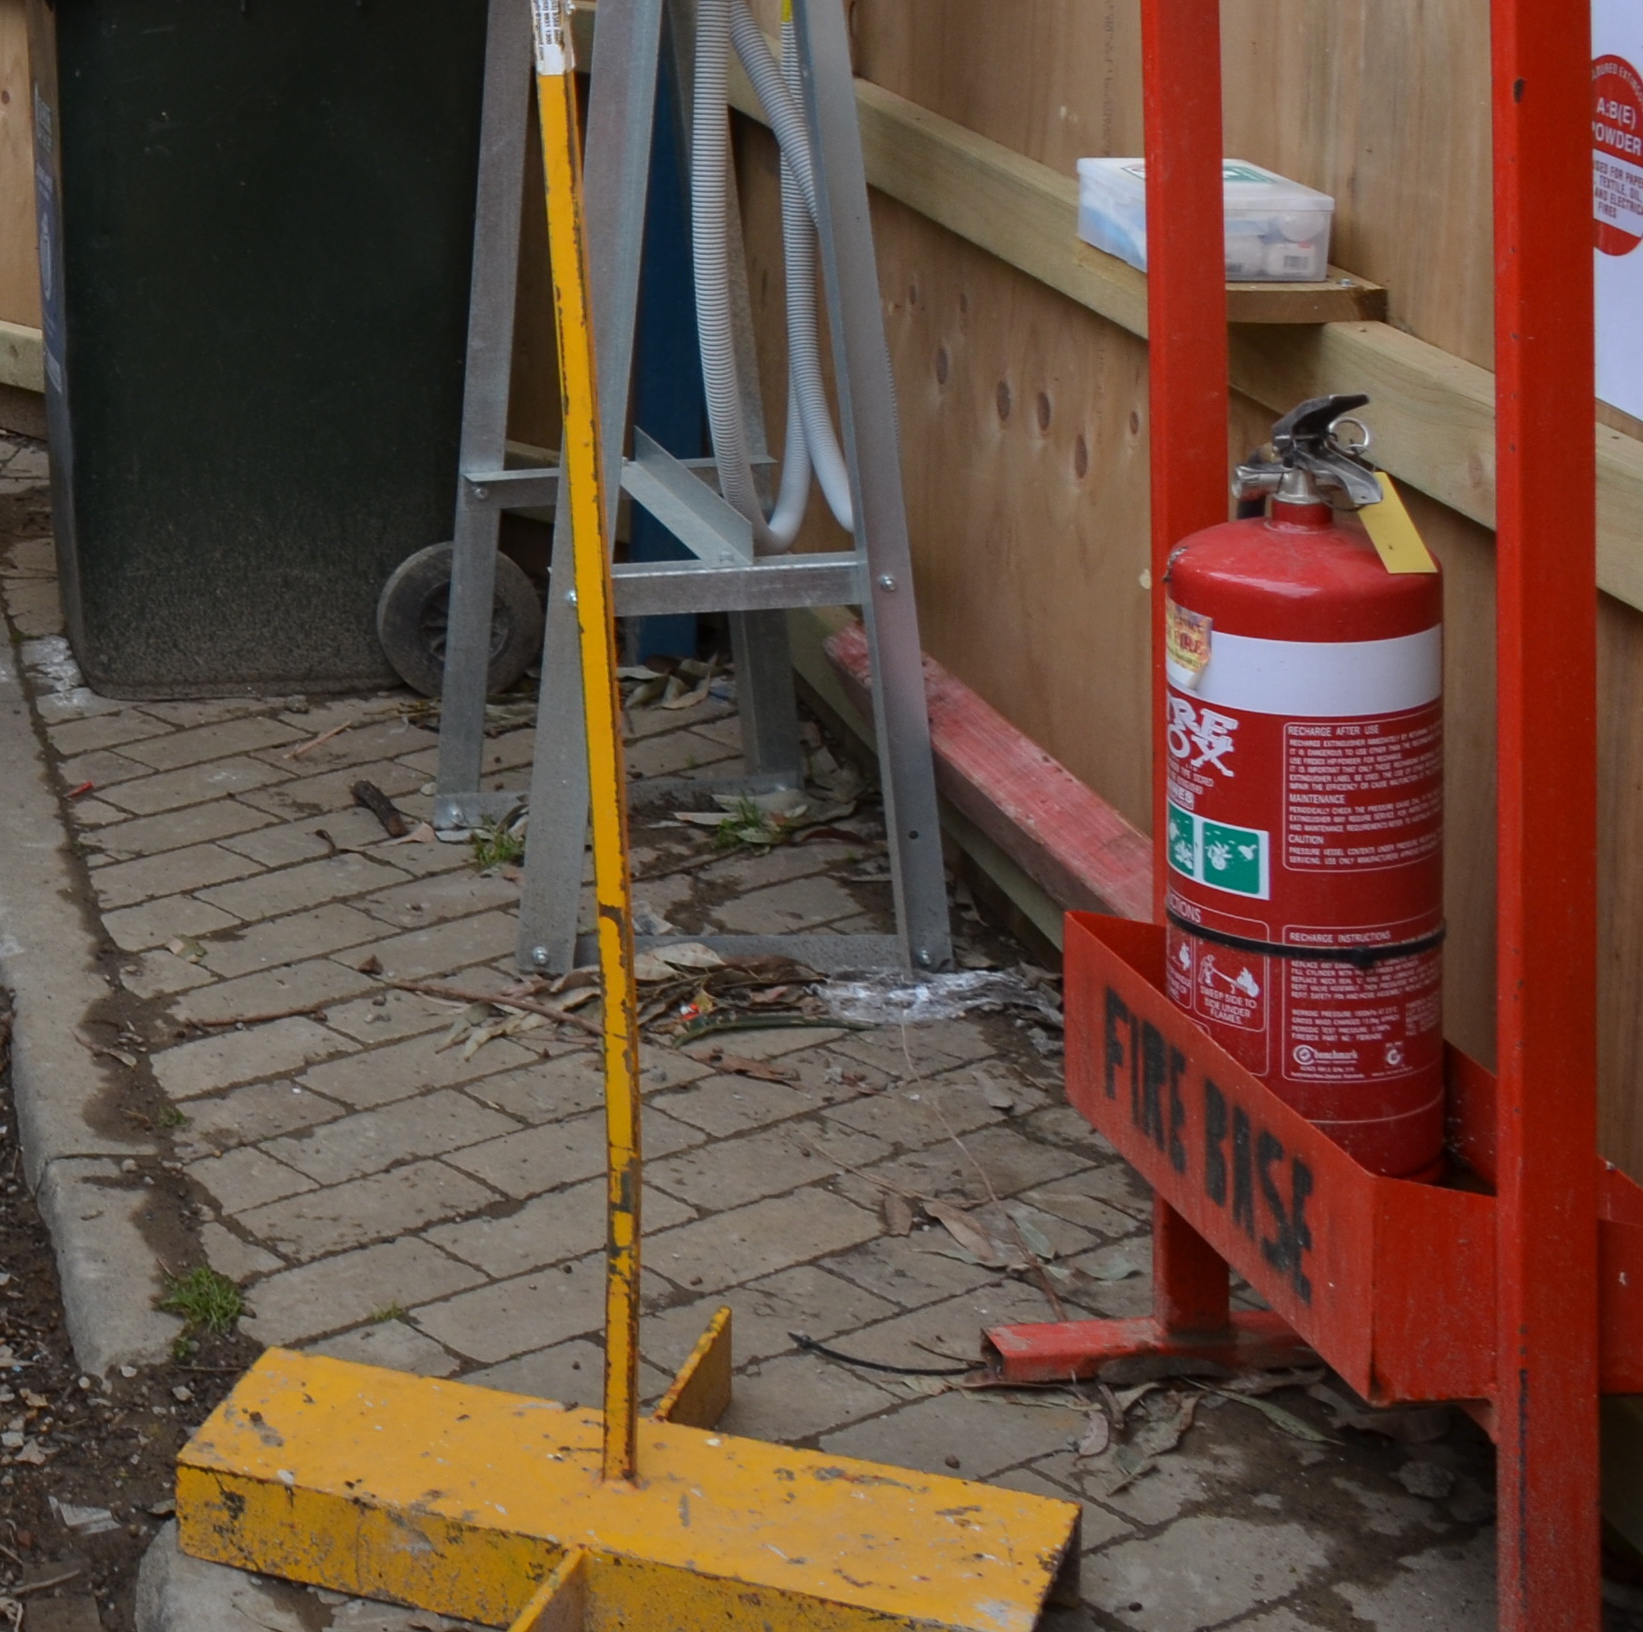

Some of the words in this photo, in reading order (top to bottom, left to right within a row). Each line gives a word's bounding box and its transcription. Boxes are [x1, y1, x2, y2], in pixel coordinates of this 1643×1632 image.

[1288, 726, 1332, 737] RECHARGE
[1336, 726, 1360, 735] AFTER
[1365, 725, 1379, 734] USE
[1168, 723, 1235, 778] OX
[1289, 794, 1346, 804] MAINTENANCE
[1288, 834, 1324, 844] CAUTION
[1290, 932, 1333, 943] RECHARGE
[1338, 931, 1390, 943] INSTRUCTIONS
[1245, 996, 1257, 1009] TO
[1221, 1002, 1251, 1018] UNDER
[1314, 1050, 1357, 1059] benchmark
[1106, 985, 1187, 1175] FIRE
[1204, 1075, 1313, 1310] BASE
